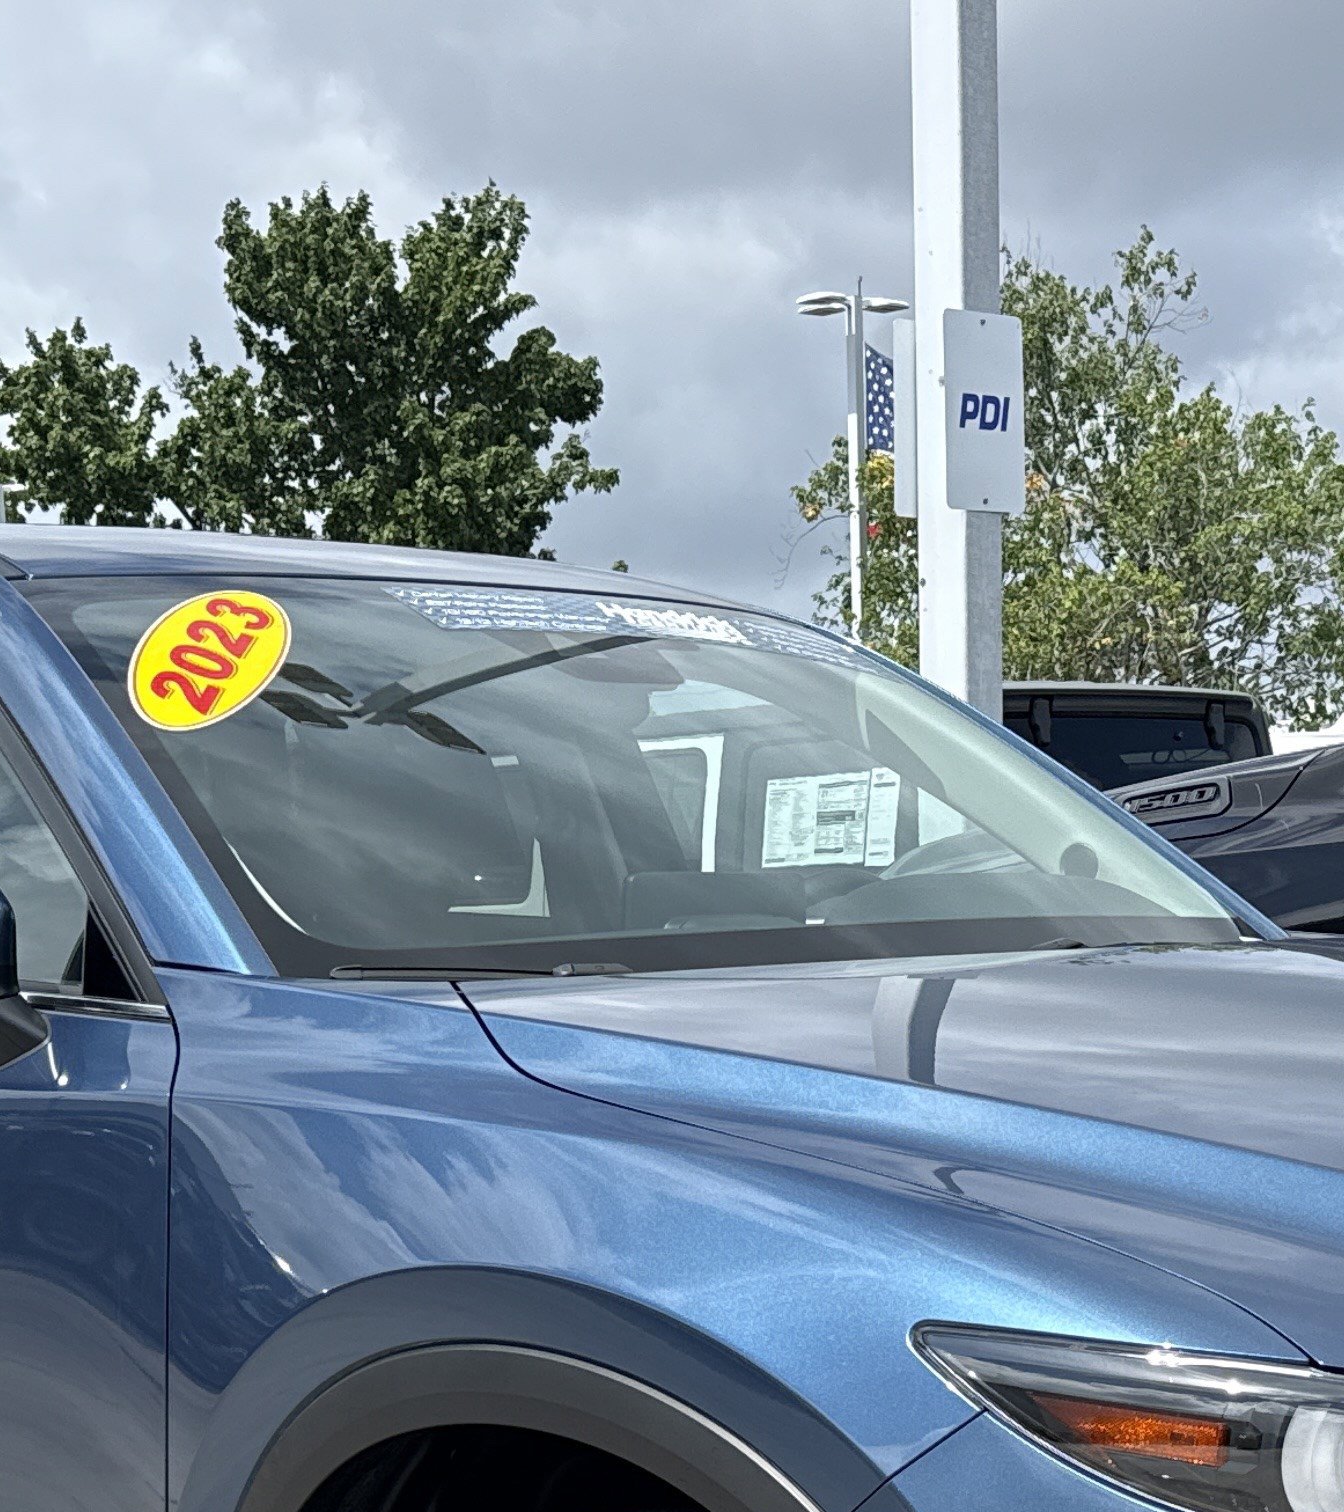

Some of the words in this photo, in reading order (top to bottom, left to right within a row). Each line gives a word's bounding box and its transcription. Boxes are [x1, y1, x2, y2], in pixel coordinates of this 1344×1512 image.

[959, 393, 1010, 432] PDI
[151, 598, 275, 716] 2023
[1125, 786, 1218, 812] 1500
